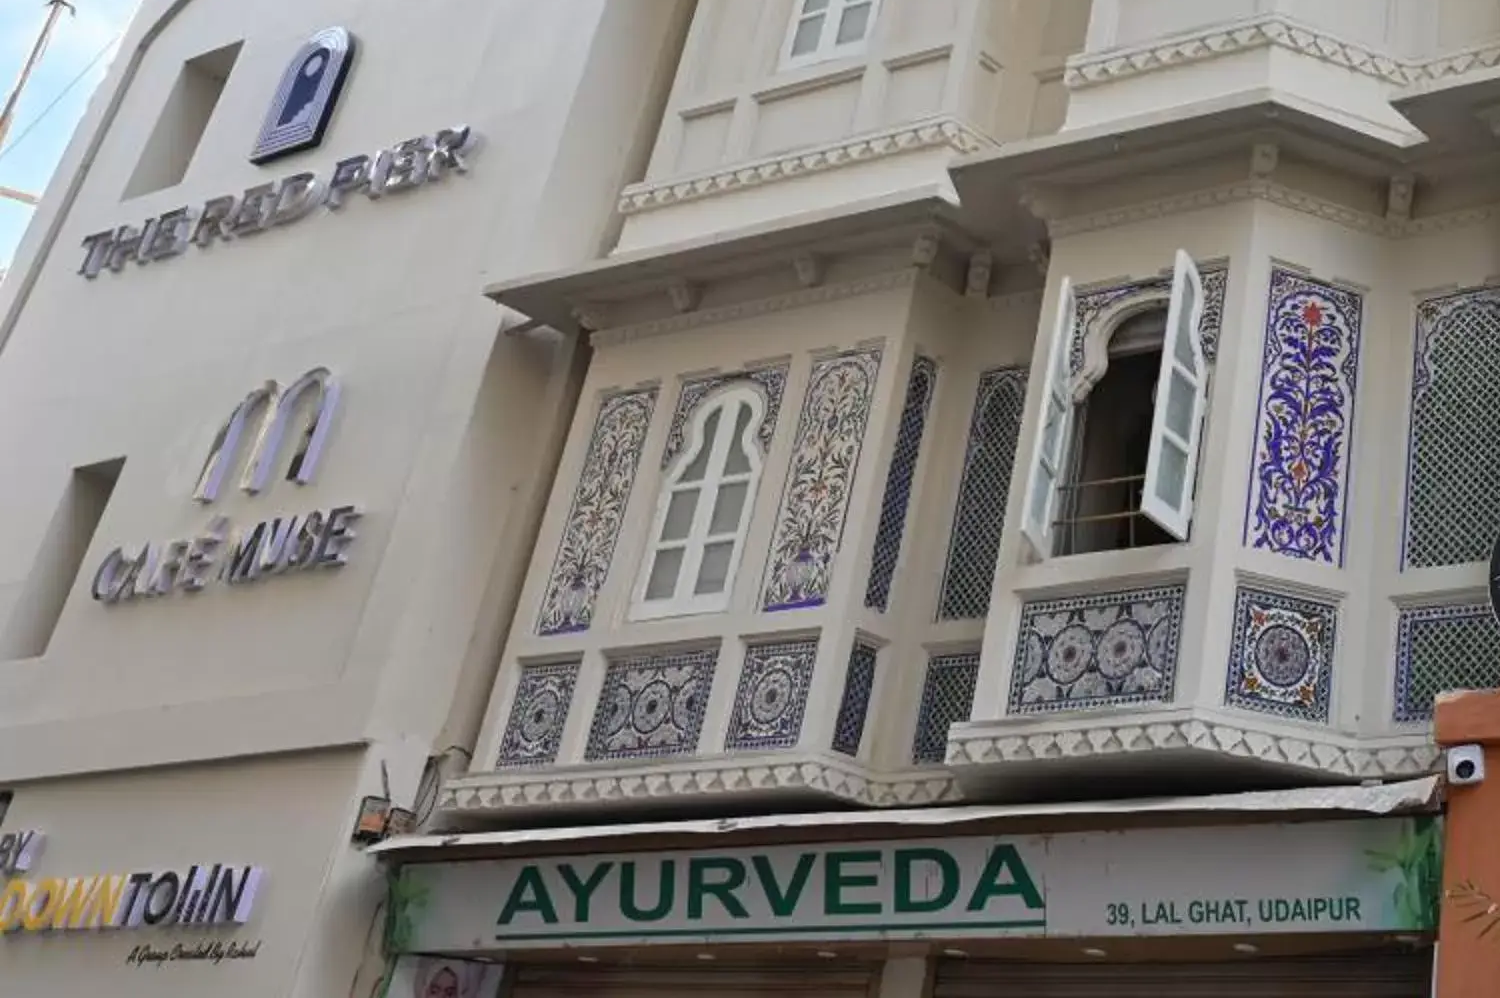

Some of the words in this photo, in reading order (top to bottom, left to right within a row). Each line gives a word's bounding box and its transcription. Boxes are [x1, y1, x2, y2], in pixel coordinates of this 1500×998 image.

[78, 206, 190, 279] THE
[189, 171, 324, 248] RED
[323, 125, 474, 211] PIER
[216, 505, 362, 585] MUSE
[0, 864, 256, 932] DOWNTOWN
[495, 843, 1047, 926] AYURVEDA
[1106, 903, 1136, 929] 39,
[1141, 902, 1183, 926] LAL
[1188, 900, 1252, 926] GHAT,
[1258, 897, 1362, 922] UDAIPUR
